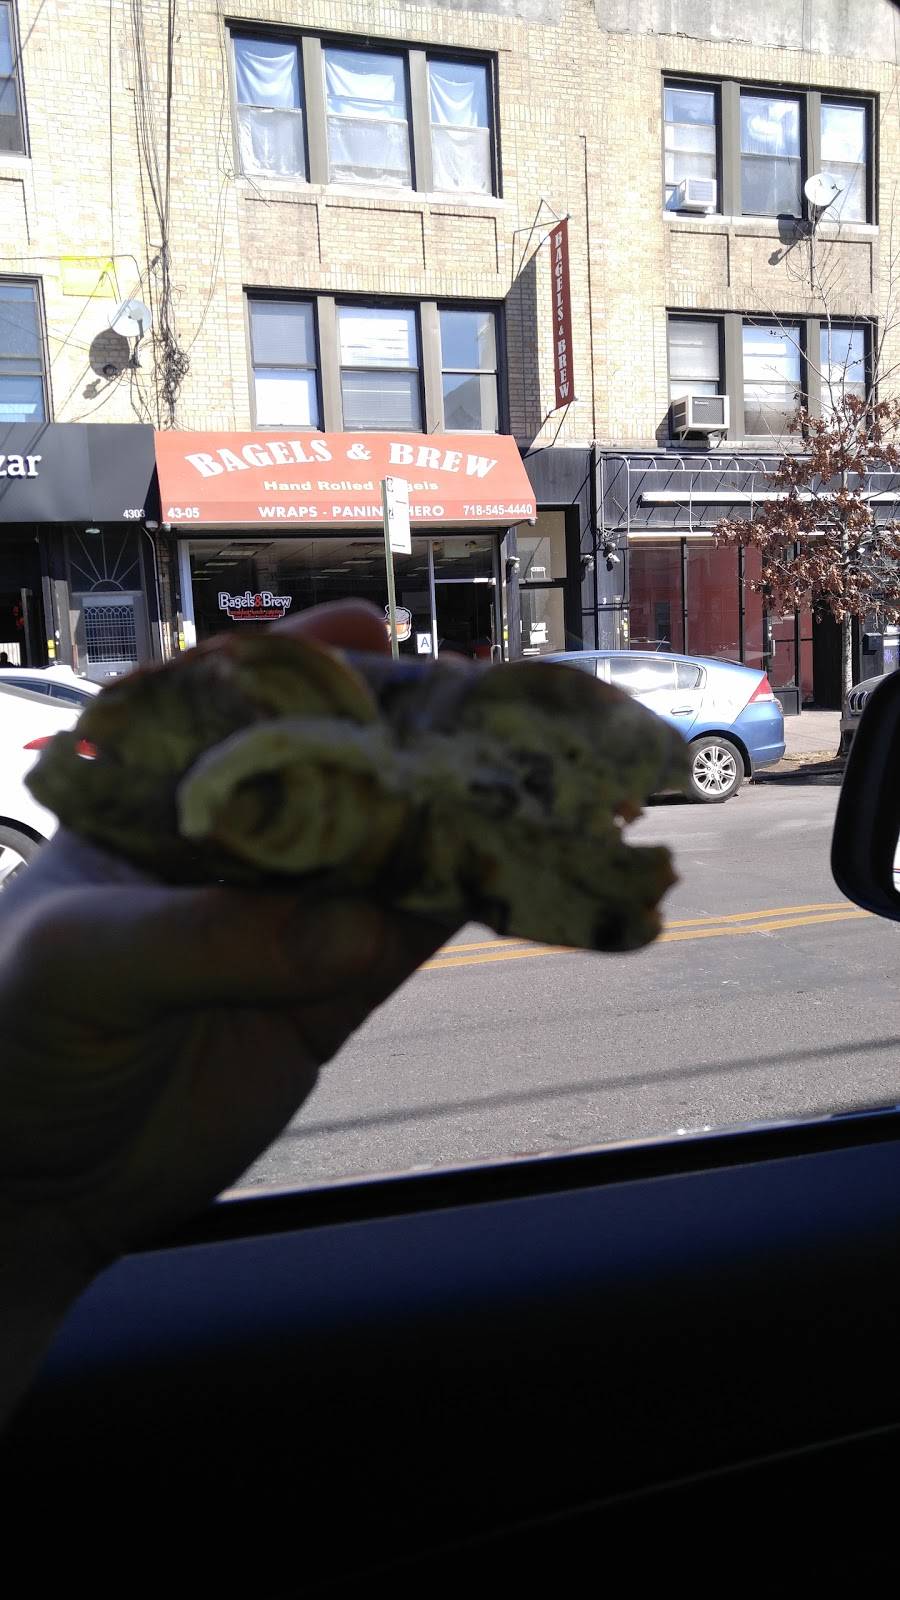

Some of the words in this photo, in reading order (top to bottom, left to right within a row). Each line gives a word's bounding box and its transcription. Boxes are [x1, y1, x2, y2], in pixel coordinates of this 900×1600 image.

[555, 231, 565, 321] BAGELS
[557, 339, 569, 399] BREW
[184, 439, 333, 478] BAGELS
[346, 443, 372, 461] &
[388, 442, 498, 479] BREW
[263, 480, 312, 491] Hand
[317, 480, 374, 491] Rolled
[167, 507, 200, 519] 43-05
[258, 505, 318, 518] WRAPS
[332, 505, 384, 517] PANIN
[463, 503, 533, 516] 718-545-4440
[420, 636, 430, 648] A
